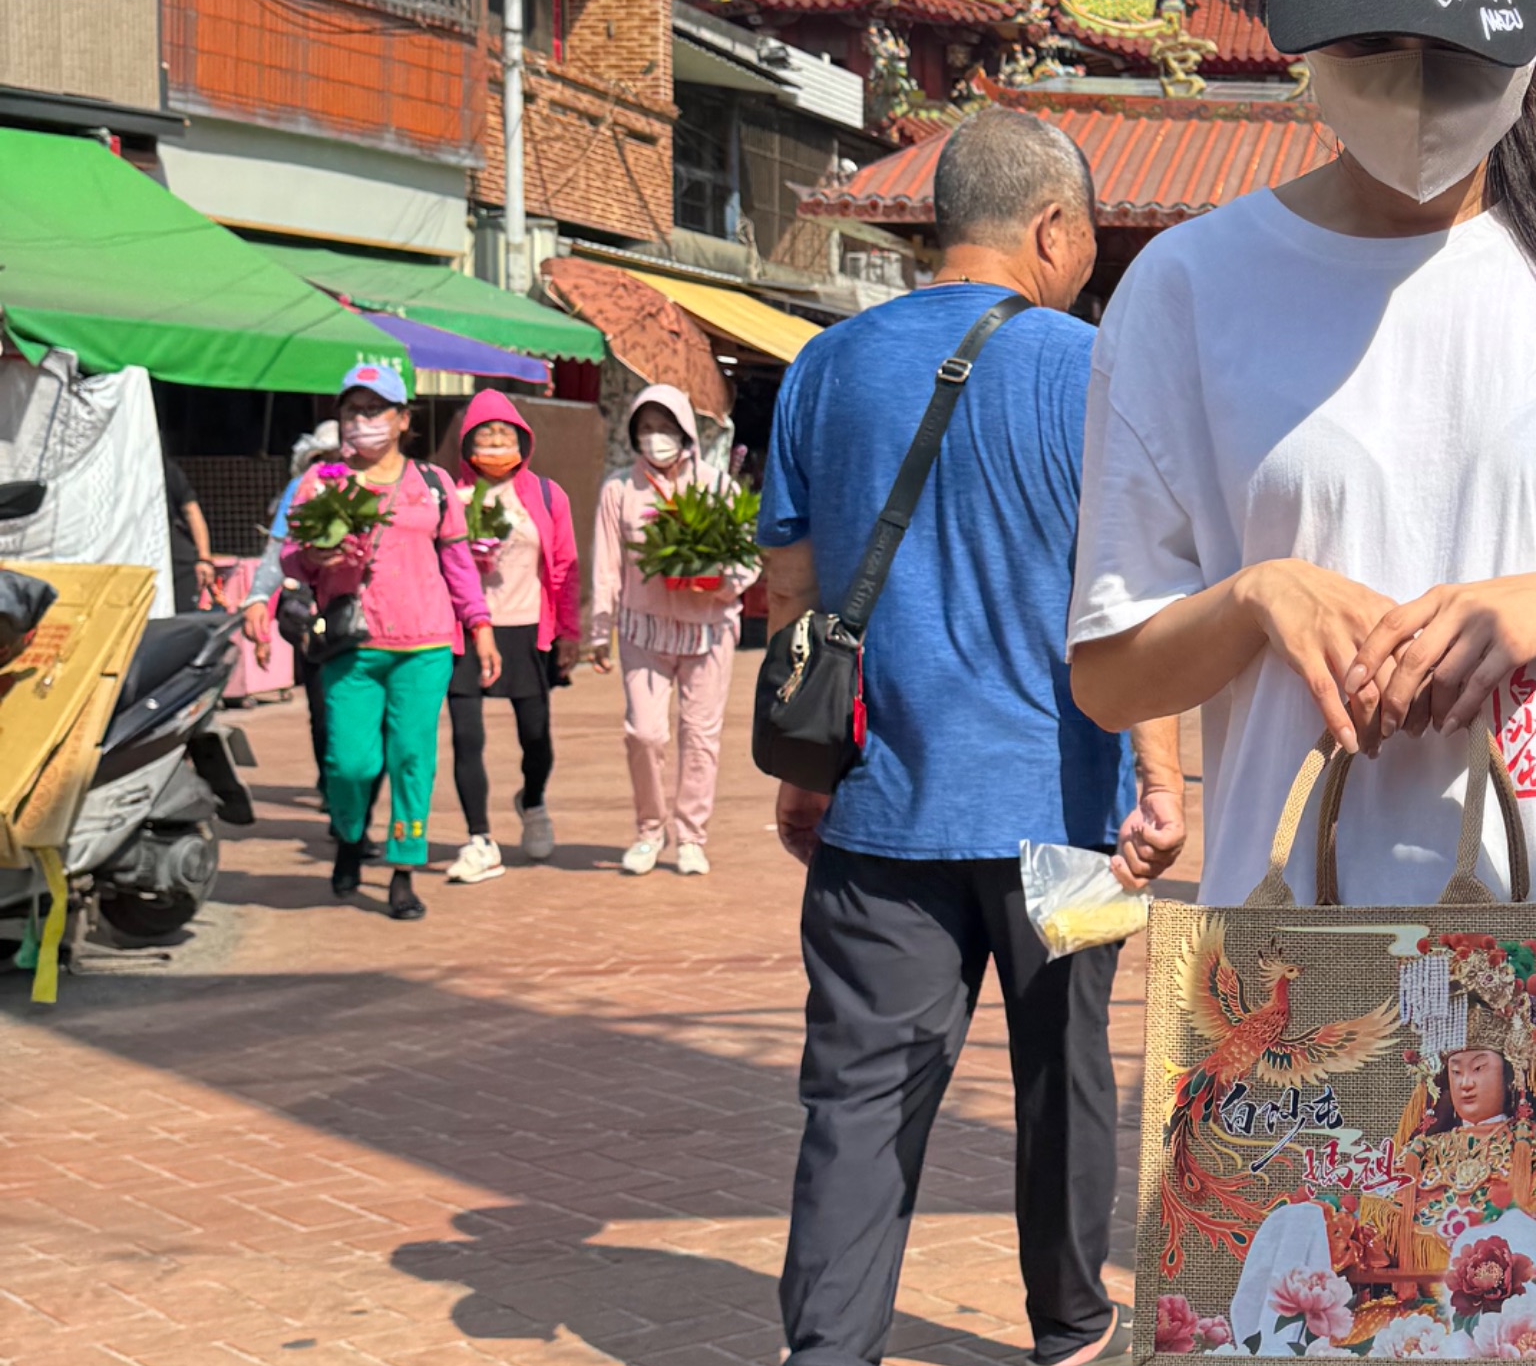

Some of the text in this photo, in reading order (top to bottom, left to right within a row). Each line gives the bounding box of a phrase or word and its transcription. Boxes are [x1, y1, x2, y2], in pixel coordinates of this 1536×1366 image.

[1218, 1081, 1344, 1174] 白沙屯
[1302, 1138, 1415, 1199] 媽祖
